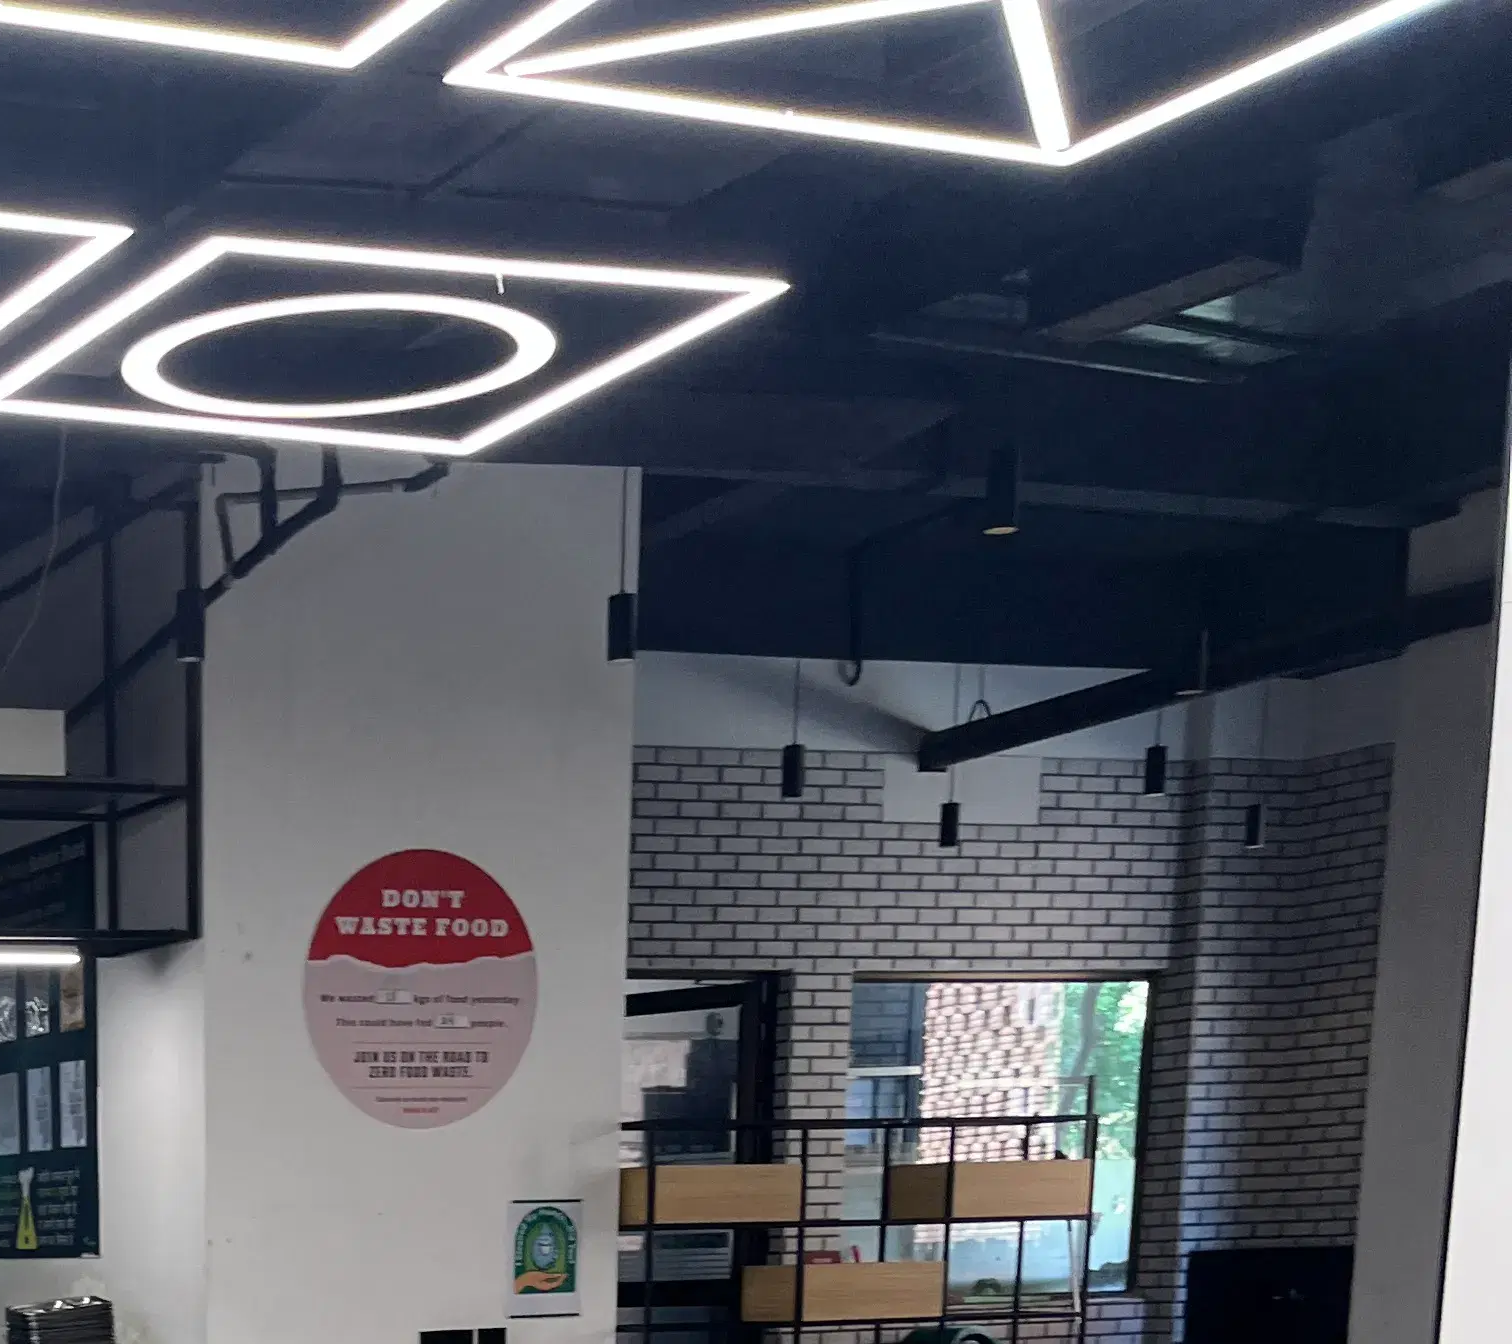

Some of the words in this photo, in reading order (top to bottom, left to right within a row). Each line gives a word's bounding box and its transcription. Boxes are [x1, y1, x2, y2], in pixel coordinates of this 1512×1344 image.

[381, 888, 465, 908] DON'T
[335, 916, 427, 936] WASTE
[435, 918, 510, 937] FOOD
[354, 1051, 378, 1063] JOIN
[382, 1051, 397, 1063] US
[399, 1051, 415, 1063] ON
[419, 1051, 439, 1063] THE
[475, 1051, 488, 1063] TO
[368, 1066, 397, 1078] ZERO
[399, 1066, 428, 1078] FOOD
